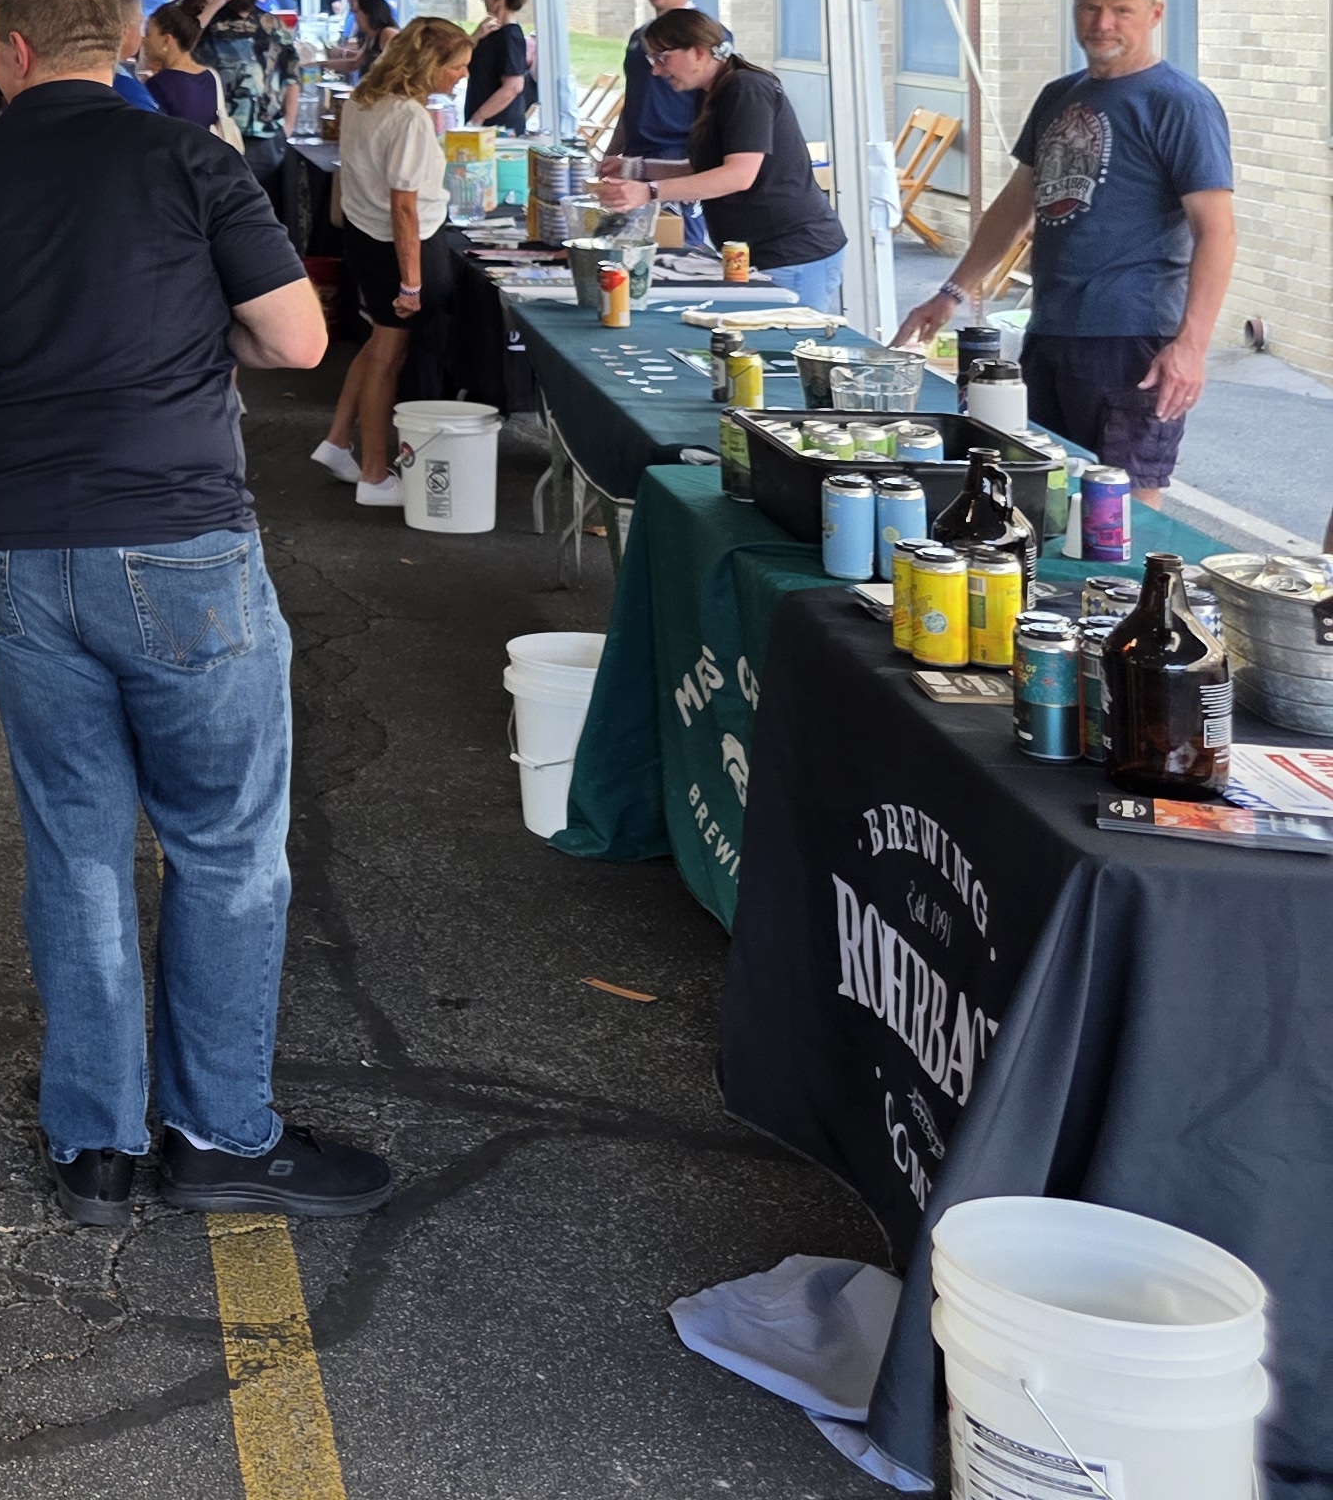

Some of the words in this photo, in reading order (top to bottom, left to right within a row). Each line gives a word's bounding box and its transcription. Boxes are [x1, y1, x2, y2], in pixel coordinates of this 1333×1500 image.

[688, 782, 741, 885] BREWI
[862, 803, 988, 939] BREWING
[979, 1425, 1029, 1452] SAFETY
